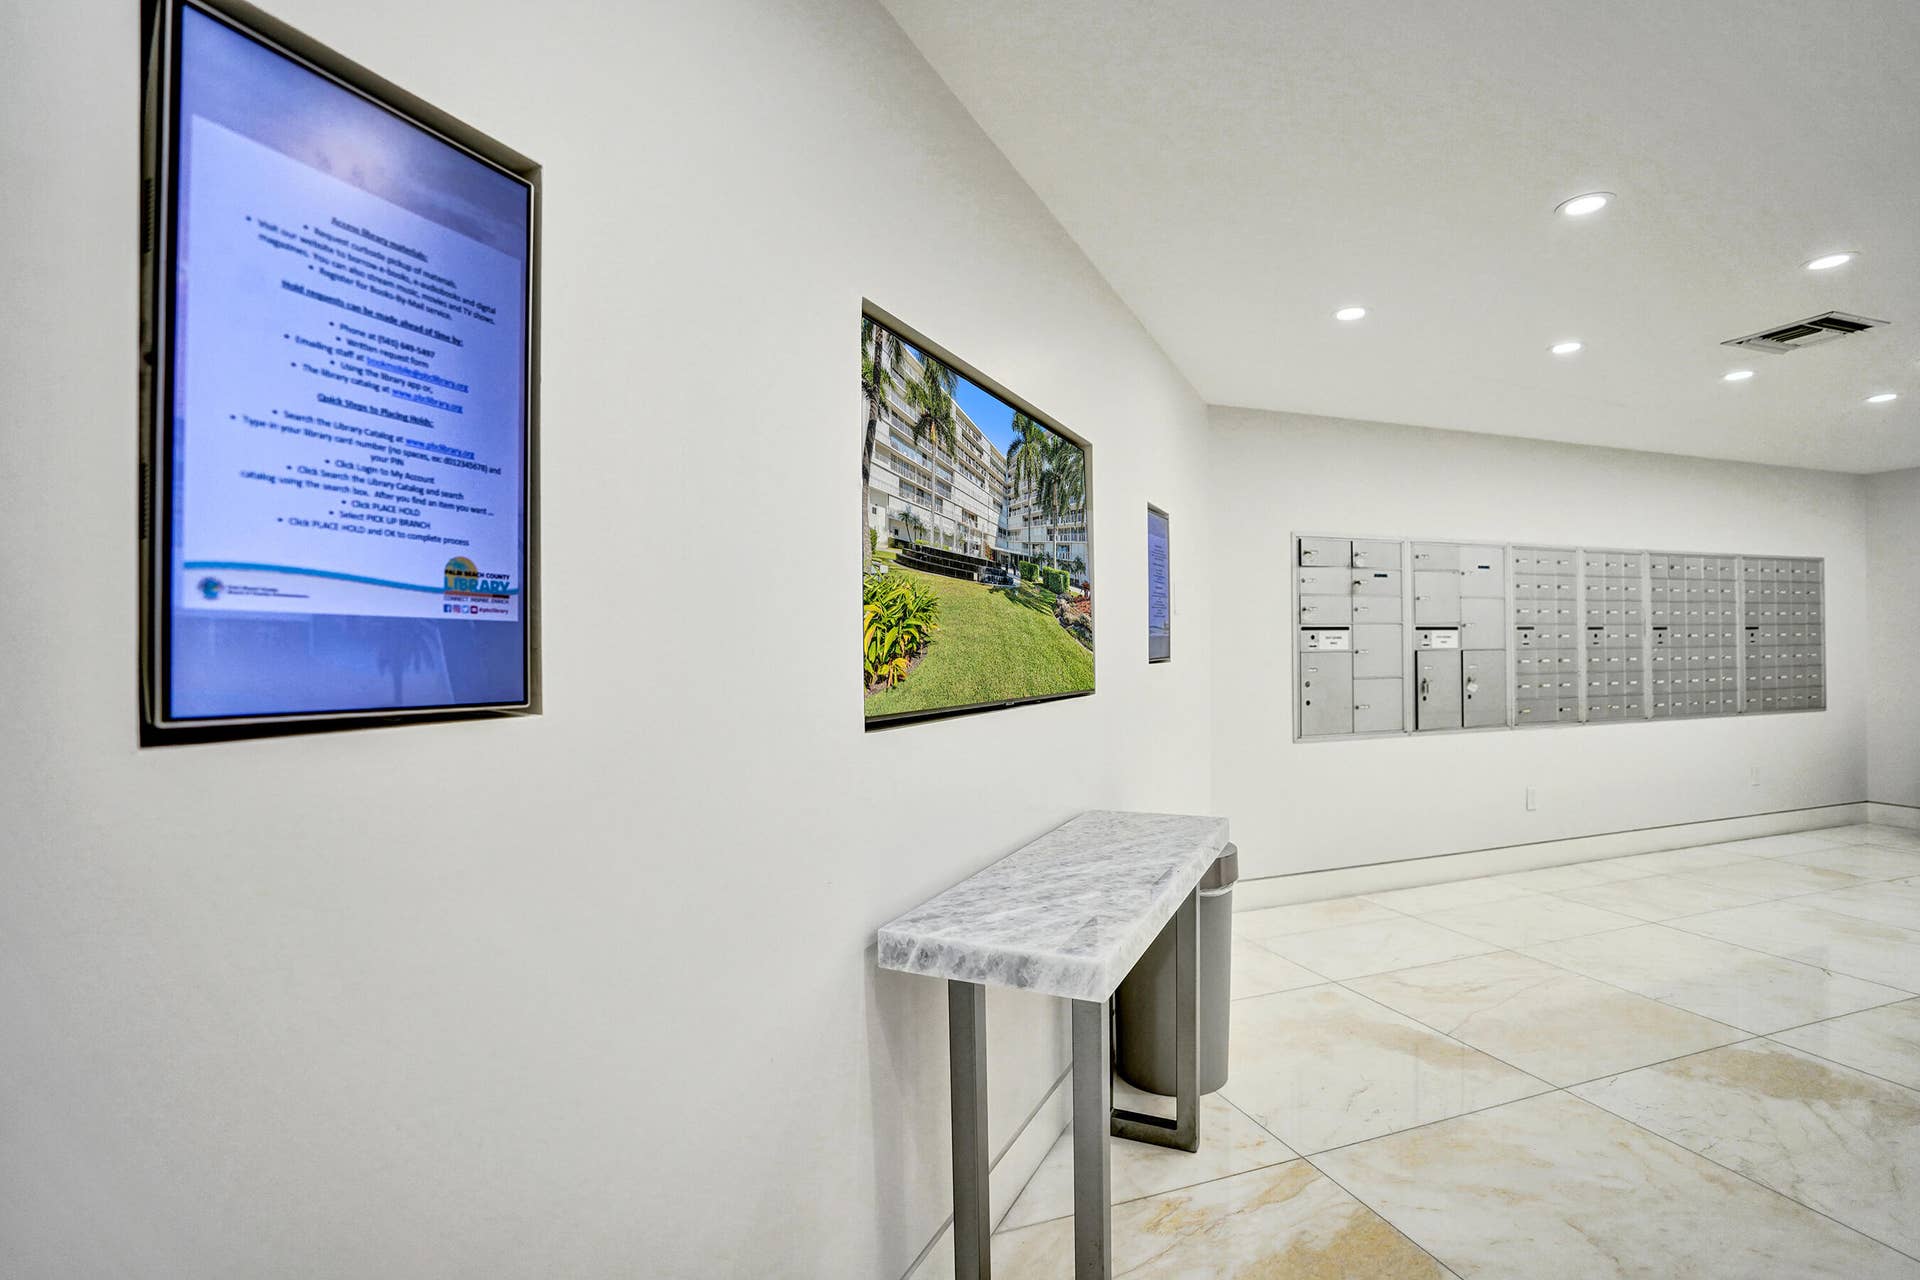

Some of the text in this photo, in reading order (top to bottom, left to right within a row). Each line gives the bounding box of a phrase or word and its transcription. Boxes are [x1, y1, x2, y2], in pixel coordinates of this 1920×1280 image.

[300, 237, 334, 253] website
[336, 250, 346, 258] to
[462, 298, 475, 307] and
[320, 267, 354, 284] Register
[356, 280, 368, 290] for
[332, 261, 346, 270] can
[349, 267, 365, 278] also
[367, 274, 395, 288] stream
[422, 294, 448, 308] movies
[448, 304, 462, 313] and
[340, 323, 366, 337] Phone
[346, 302, 361, 314] can
[362, 305, 373, 318] be
[374, 312, 398, 326] made
[400, 320, 424, 334] ahead
[425, 328, 433, 338] of
[295, 336, 332, 355] Emailing
[379, 348, 409, 363] request
[302, 363, 318, 374] The
[321, 368, 348, 384] library
[350, 378, 380, 392] catalog
[365, 368, 378, 378] the
[369, 405, 378, 415] to
[316, 418, 331, 427] the
[355, 440, 386, 452] number
[489, 466, 502, 476] and
[370, 455, 388, 463] your
[297, 465, 318, 476] Click
[320, 470, 349, 480] Search
[351, 475, 365, 484] the
[396, 482, 424, 496] Catalog
[426, 488, 440, 496] and
[441, 490, 464, 500] search
[335, 460, 354, 469] Click
[380, 468, 389, 476] to
[390, 470, 403, 480] My
[405, 472, 435, 484] Account
[240, 471, 275, 484] catalog
[278, 478, 302, 488] using
[305, 480, 320, 488] the
[323, 484, 350, 493] search
[412, 496, 426, 506] find
[351, 500, 420, 516] Click PLACE HOLD
[288, 517, 309, 527] Click
[311, 520, 338, 530] PLACE
[341, 524, 366, 534] HOLD
[407, 532, 442, 543] complete
[443, 537, 470, 546] process
[445, 577, 510, 593] LIBRARY
